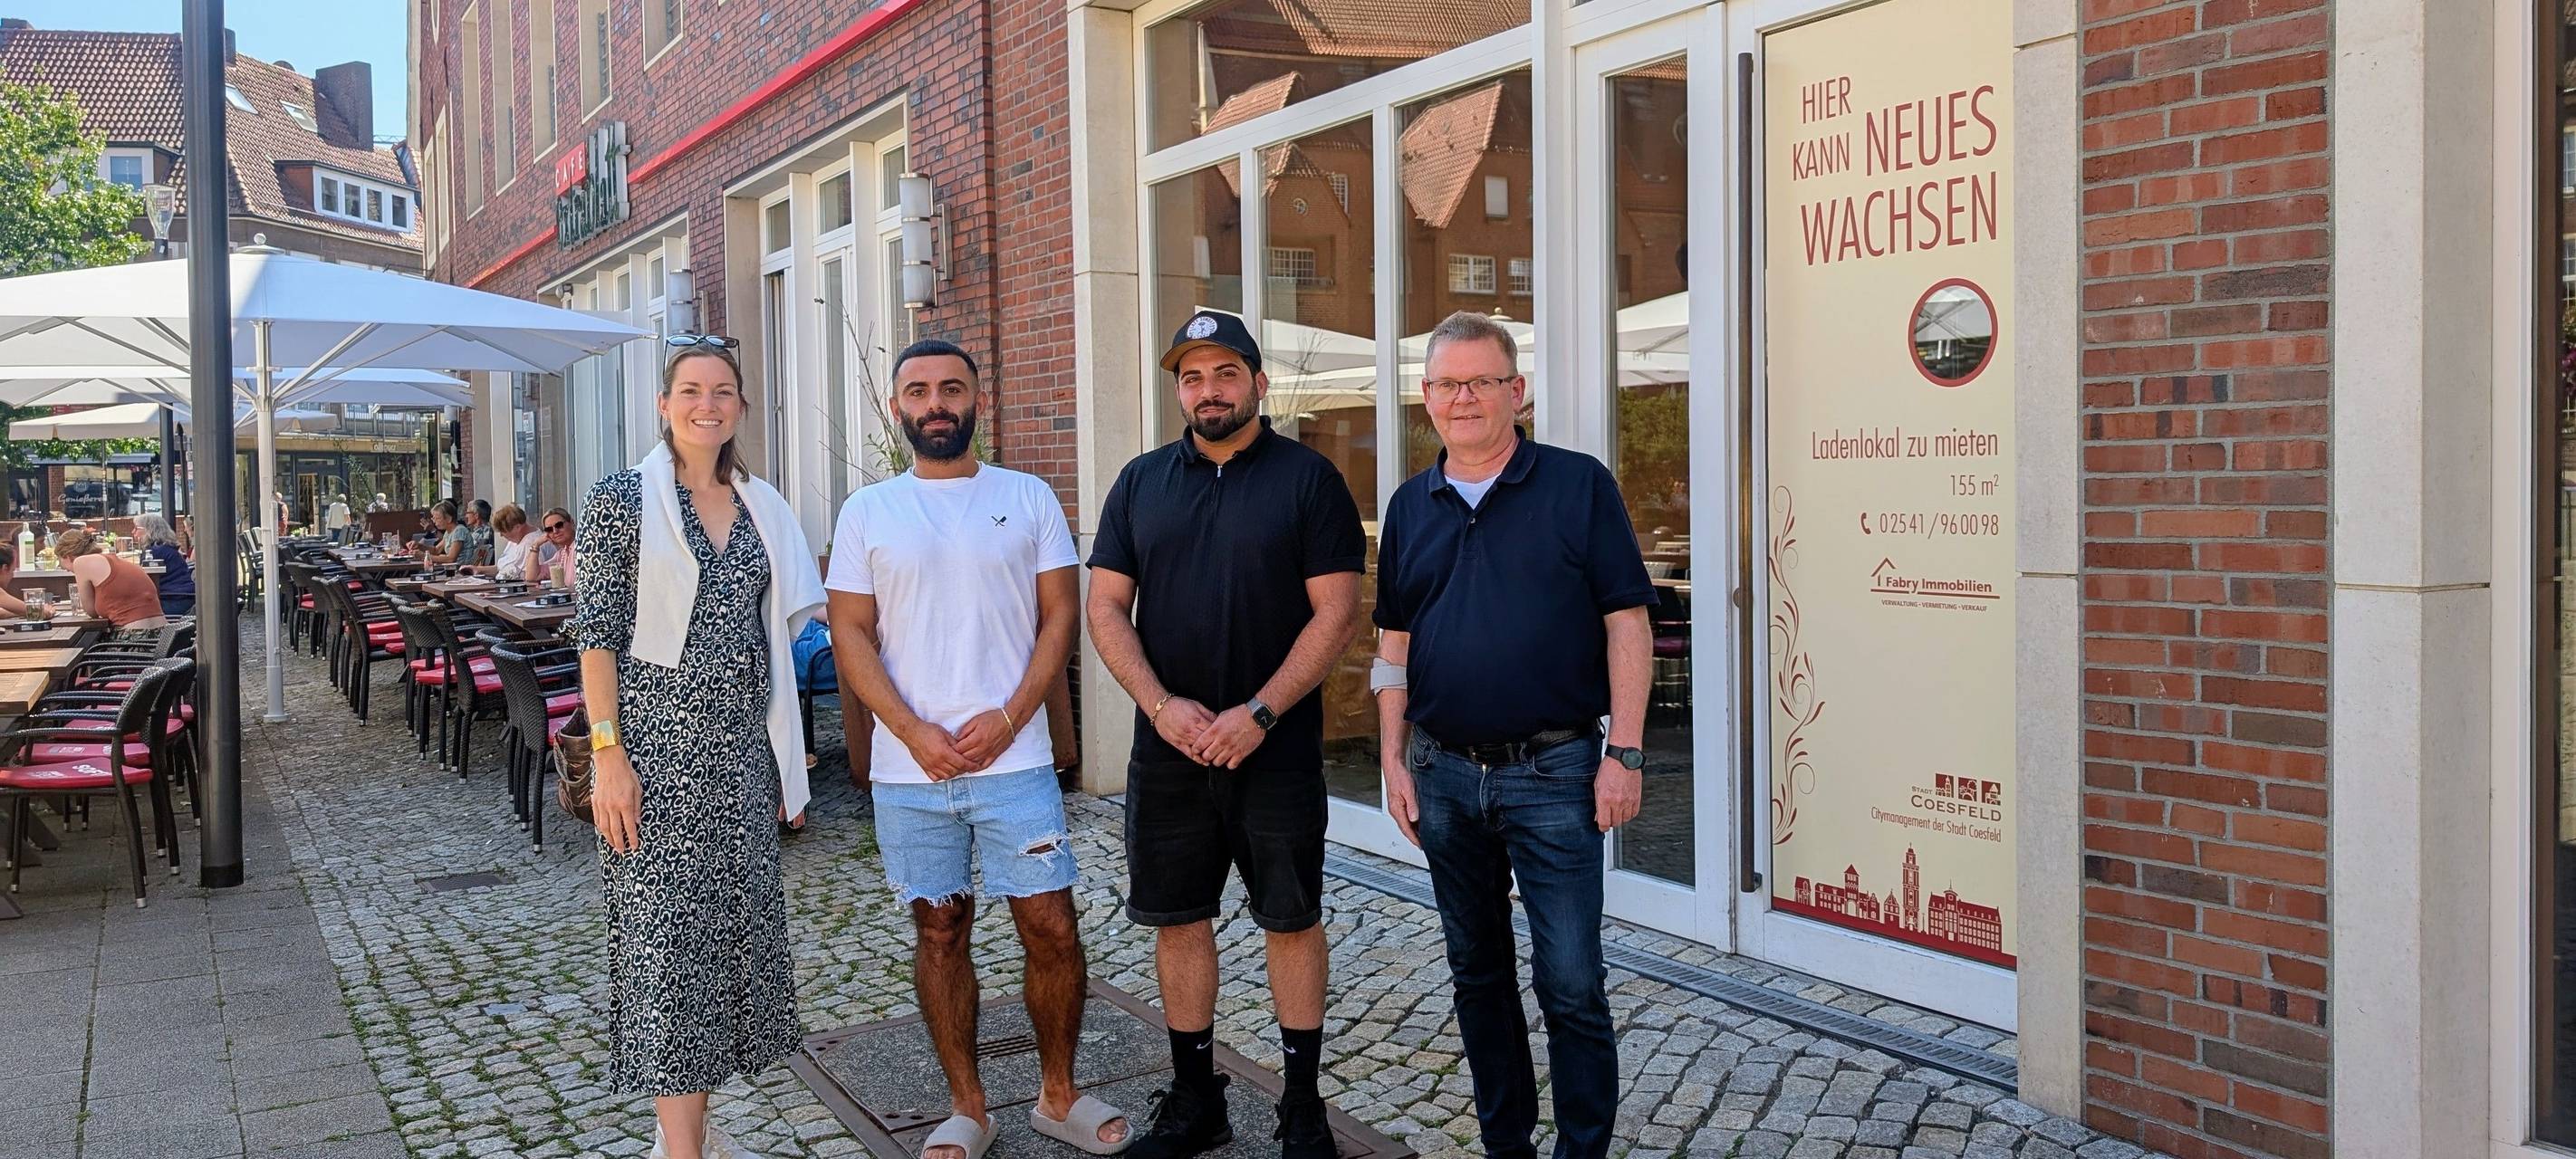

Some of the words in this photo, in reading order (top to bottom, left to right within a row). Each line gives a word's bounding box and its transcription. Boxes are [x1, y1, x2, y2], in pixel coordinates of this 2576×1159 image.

[1802, 76, 1851, 124] HIER
[1793, 132, 1850, 181] KANN
[1866, 85, 1997, 177] NEUES
[1800, 170, 1997, 265] WACHSEN
[1812, 426, 1900, 459] Ladenlokal
[1907, 436, 1927, 457] zu
[1935, 428, 1998, 456] mieten
[1950, 474, 1976, 496] 155
[1886, 577, 1918, 593] Fabry
[1922, 578, 1992, 592] Immobilien
[1881, 599, 1918, 608] VERWALTUNG
[1922, 602, 1957, 610] VERMIETUNG
[1961, 604, 1987, 612] VERKAUF
[1871, 807, 1930, 828] Citymanagement
[1932, 818, 1945, 832] der
[1946, 820, 1966, 836] Stadt
[1969, 824, 2001, 843] Coesfeld
